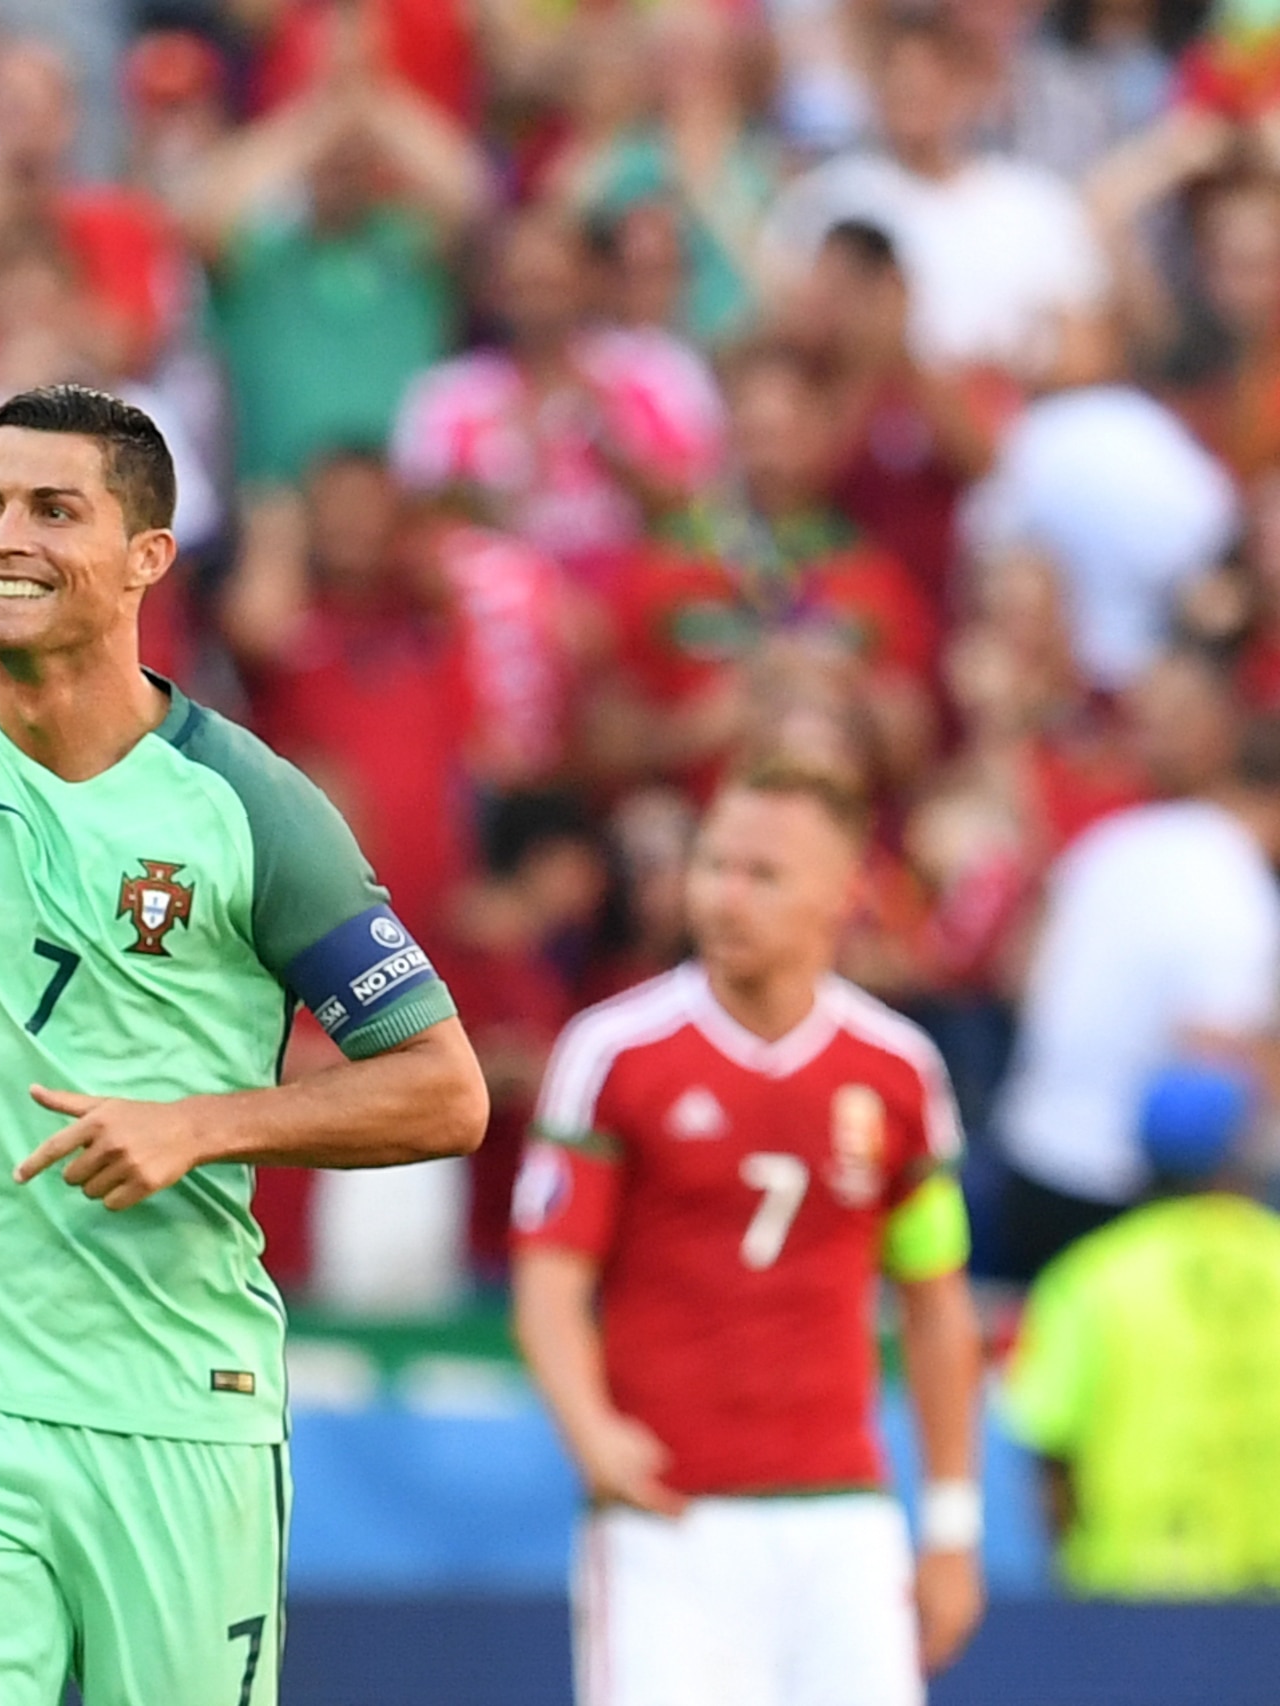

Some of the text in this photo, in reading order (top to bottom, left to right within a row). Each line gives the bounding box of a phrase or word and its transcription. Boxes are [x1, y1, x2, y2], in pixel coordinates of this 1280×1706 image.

[25, 938, 81, 1036] 7
[352, 972, 387, 1001] NO
[383, 957, 410, 978] TO
[739, 1152, 809, 1271] 7
[228, 1614, 267, 1706] 7
